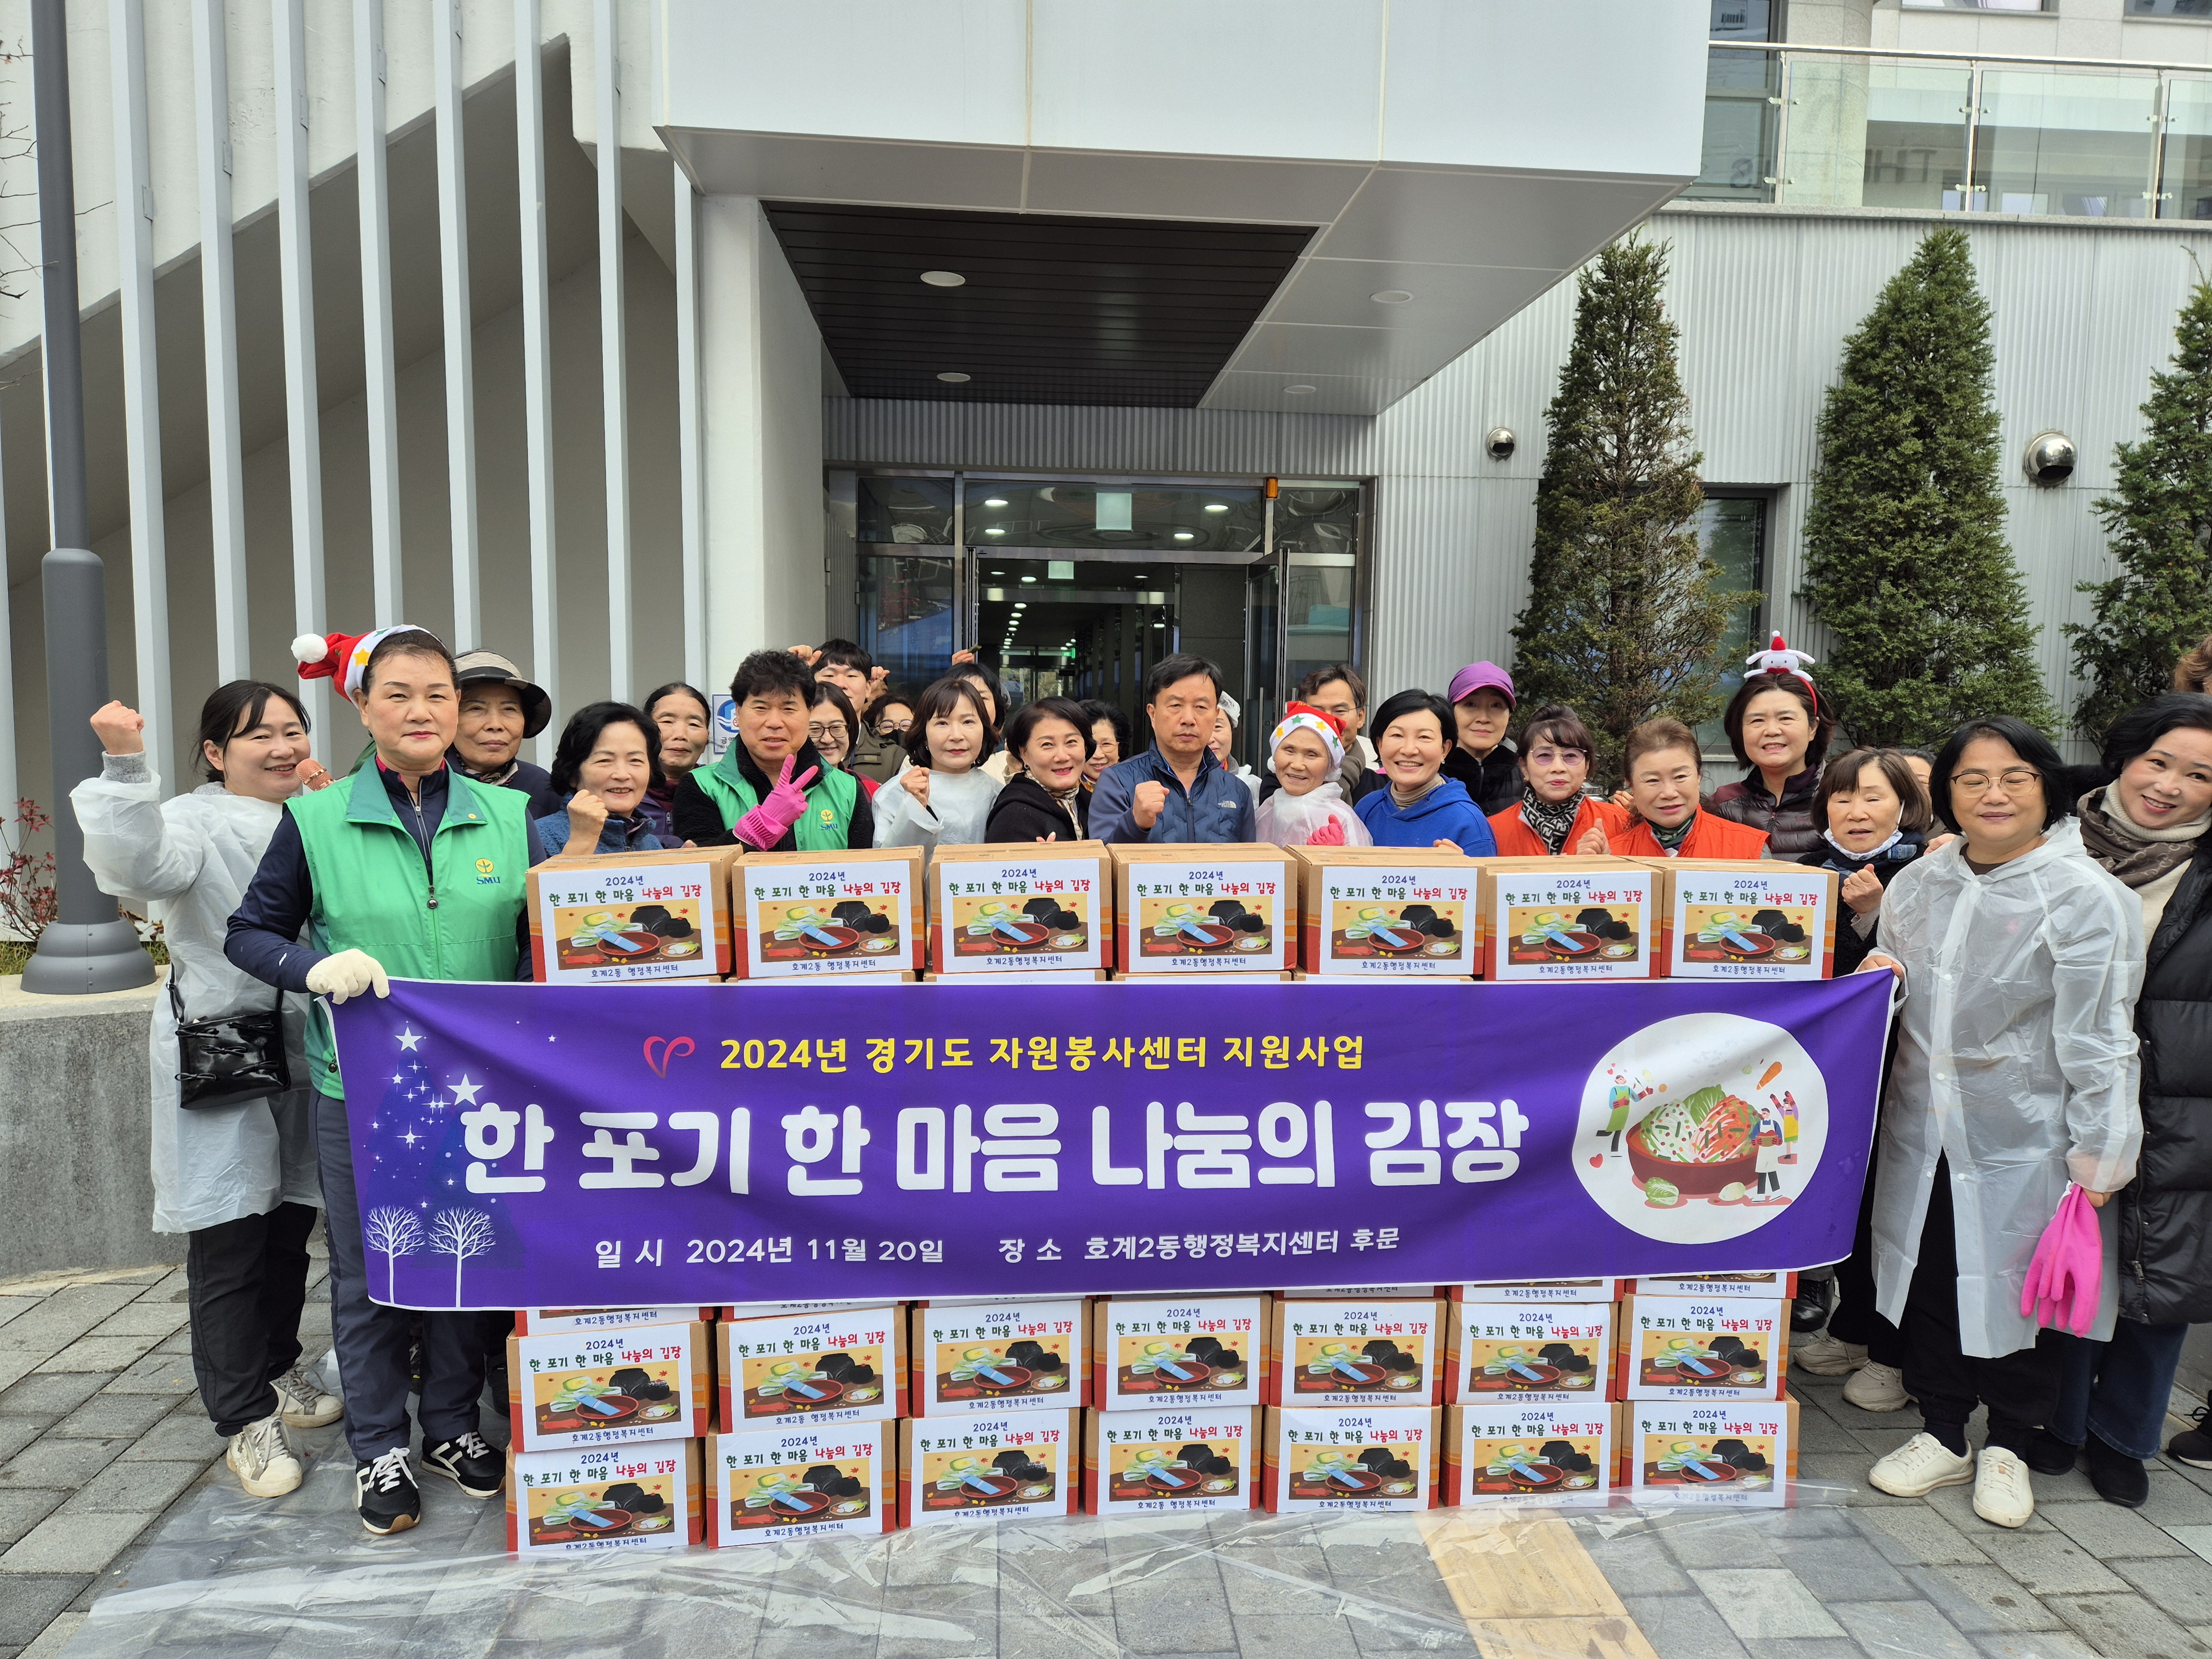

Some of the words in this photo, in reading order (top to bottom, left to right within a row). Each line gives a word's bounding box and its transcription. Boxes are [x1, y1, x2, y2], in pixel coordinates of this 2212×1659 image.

[809, 872, 845, 881] 2024년
[1002, 869, 1036, 878] 2024년
[1189, 871, 1223, 880] 2024년
[476, 876, 501, 885] SMU
[606, 875, 643, 886] 2024년
[1382, 875, 1416, 885] 2024년
[1557, 880, 1590, 889] 2024년
[1734, 880, 1767, 890] 2024년
[754, 888, 765, 900] 한
[772, 887, 791, 896] 포기
[799, 885, 810, 898] 한
[816, 884, 836, 897] 마음
[843, 883, 873, 895] 나눔의
[880, 881, 901, 894] 김장
[949, 883, 959, 895] 한
[966, 883, 984, 893] 포기
[992, 881, 1002, 894] 한
[1009, 881, 1027, 893] 마음
[1035, 880, 1063, 893] 나눔의
[1071, 879, 1090, 891] 김장
[1137, 884, 1147, 896] 한
[1154, 885, 1172, 894] 포기
[1179, 883, 1189, 896] 한
[1196, 883, 1213, 895] 마음
[1222, 883, 1249, 895] 나눔의
[1256, 883, 1276, 894] 김장
[549, 894, 560, 906] 한
[568, 893, 588, 902] 포기
[595, 890, 606, 903] 한
[613, 889, 634, 901] 마음
[642, 886, 672, 900] 나눔의
[680, 884, 701, 898] 김장
[1330, 886, 1340, 899] 한
[1347, 888, 1364, 897] 포기
[1371, 887, 1381, 899] 한
[1388, 888, 1406, 900] 마음
[1414, 888, 1441, 900] 나눔의
[1449, 888, 1468, 900] 김장
[1506, 893, 1515, 905] 한
[1522, 894, 1540, 902] 포기
[1547, 892, 1557, 904] 한
[1563, 891, 1581, 904] 마음
[1589, 891, 1616, 903] 나눔의
[1624, 890, 1642, 902] 김장
[1683, 890, 1693, 902] 한
[1699, 892, 1717, 901] 포기
[1724, 891, 1734, 904] 한
[1740, 893, 1757, 904] 마음
[1766, 893, 1792, 905] 나눔의
[1799, 894, 1818, 905] 김장
[792, 962, 821, 971] 호계2동
[827, 959, 875, 970] 행정복지센터
[987, 956, 1062, 966] 호계2동행정복지센터
[1172, 958, 1245, 967] 호계2동행정복지센터
[1362, 961, 1435, 970] 호계2동행정복지센터
[592, 969, 621, 978] 호계2동
[628, 964, 677, 976] 행정복지센터
[1540, 965, 1612, 974] 호계2동행정복지센터
[1713, 965, 1785, 974] 호계2동행정복지센터
[721, 1039, 847, 1073] 2024년
[866, 1038, 973, 1073] 경기도
[990, 1036, 1206, 1071] 자원봉사센터
[1224, 1036, 1363, 1069] 지원사업
[460, 1102, 555, 1195] 한
[578, 1107, 750, 1194] 포기
[781, 1105, 871, 1196] 한
[896, 1103, 1062, 1193] 마음
[1092, 1100, 1335, 1190] 나눔의
[1364, 1099, 1530, 1186] 김장
[596, 1240, 621, 1269] 일
[634, 1239, 662, 1267] 시
[686, 1237, 791, 1263] 2024년
[807, 1238, 866, 1261] 11월
[879, 1240, 943, 1262] 20일
[999, 1239, 1025, 1263] 장
[1036, 1239, 1062, 1260] 소
[1084, 1230, 1338, 1260] 호계2동행정복지센터
[1350, 1228, 1400, 1251] 후문
[1504, 1288, 1577, 1298] 호계2동행정복지센터
[1678, 1283, 1751, 1293] 호계2동행정복지센터
[986, 1312, 1020, 1322] 2024년
[1167, 1308, 1200, 1317] 2024년
[1344, 1312, 1377, 1321] 2024년
[1691, 1307, 1723, 1316] 2024년
[575, 1311, 657, 1326] 호계2동행정복지센터
[1520, 1314, 1553, 1323] 2024년
[1641, 1316, 1651, 1329] 한
[1657, 1318, 1674, 1328] 포기
[1681, 1318, 1691, 1330] 한
[1697, 1318, 1714, 1331] 마음
[1722, 1319, 1748, 1331] 나눔의
[1755, 1319, 1772, 1331] 김장
[794, 1323, 830, 1335] 2024년
[933, 1330, 943, 1342] 한
[950, 1329, 968, 1339] 포기
[975, 1327, 985, 1339] 한
[992, 1325, 1010, 1338] 마음
[1018, 1323, 1046, 1335] 나눔의
[1053, 1321, 1073, 1333] 김장
[1116, 1323, 1125, 1335] 한
[1132, 1323, 1149, 1332] 포기
[1157, 1321, 1166, 1334] 한
[1173, 1321, 1191, 1333] 마음
[1198, 1319, 1225, 1332] 나눔의
[1233, 1318, 1251, 1331] 김장
[1293, 1323, 1303, 1335] 한
[1310, 1324, 1327, 1333] 포기
[1334, 1323, 1344, 1335] 한
[1350, 1323, 1368, 1335] 마음
[1375, 1323, 1402, 1335] 나눔의
[1409, 1323, 1428, 1334] 김장
[1470, 1325, 1479, 1338] 한
[1486, 1326, 1504, 1336] 포기
[1510, 1325, 1520, 1338] 한
[1526, 1326, 1544, 1338] 마음
[1551, 1327, 1579, 1338] 나눔의
[1585, 1326, 1603, 1337] 김장
[586, 1339, 623, 1350] 2024년
[738, 1344, 749, 1358] 한
[757, 1343, 775, 1354] 포기
[783, 1340, 794, 1354] 한
[800, 1338, 820, 1351] 마음
[828, 1334, 857, 1348] 나눔의
[865, 1331, 885, 1344] 김장
[529, 1359, 540, 1372] 한
[547, 1357, 567, 1368] 포기
[575, 1355, 586, 1368] 한
[593, 1352, 614, 1365] 마음
[622, 1349, 652, 1363] 나눔의
[660, 1346, 681, 1359] 김장
[1669, 1389, 1740, 1397] 호계2동행정복지센터
[968, 1397, 1044, 1410] 호계2동행정복지센터
[1149, 1394, 1221, 1404] 호계2동행정복지센터
[776, 1416, 805, 1424] 호계2동
[811, 1410, 859, 1422] 행정복지센터
[1159, 1416, 1192, 1425] 2024년
[572, 1427, 653, 1442] 호계2동행정복지센터
[1107, 1431, 1117, 1443] 한
[1123, 1430, 1141, 1439] 포기
[1148, 1429, 1158, 1441] 한
[1165, 1428, 1182, 1440] 마음
[1190, 1427, 1217, 1439] 나눔의
[1224, 1426, 1243, 1437] 김장
[1171, 1500, 1215, 1509] 행정복지센터
